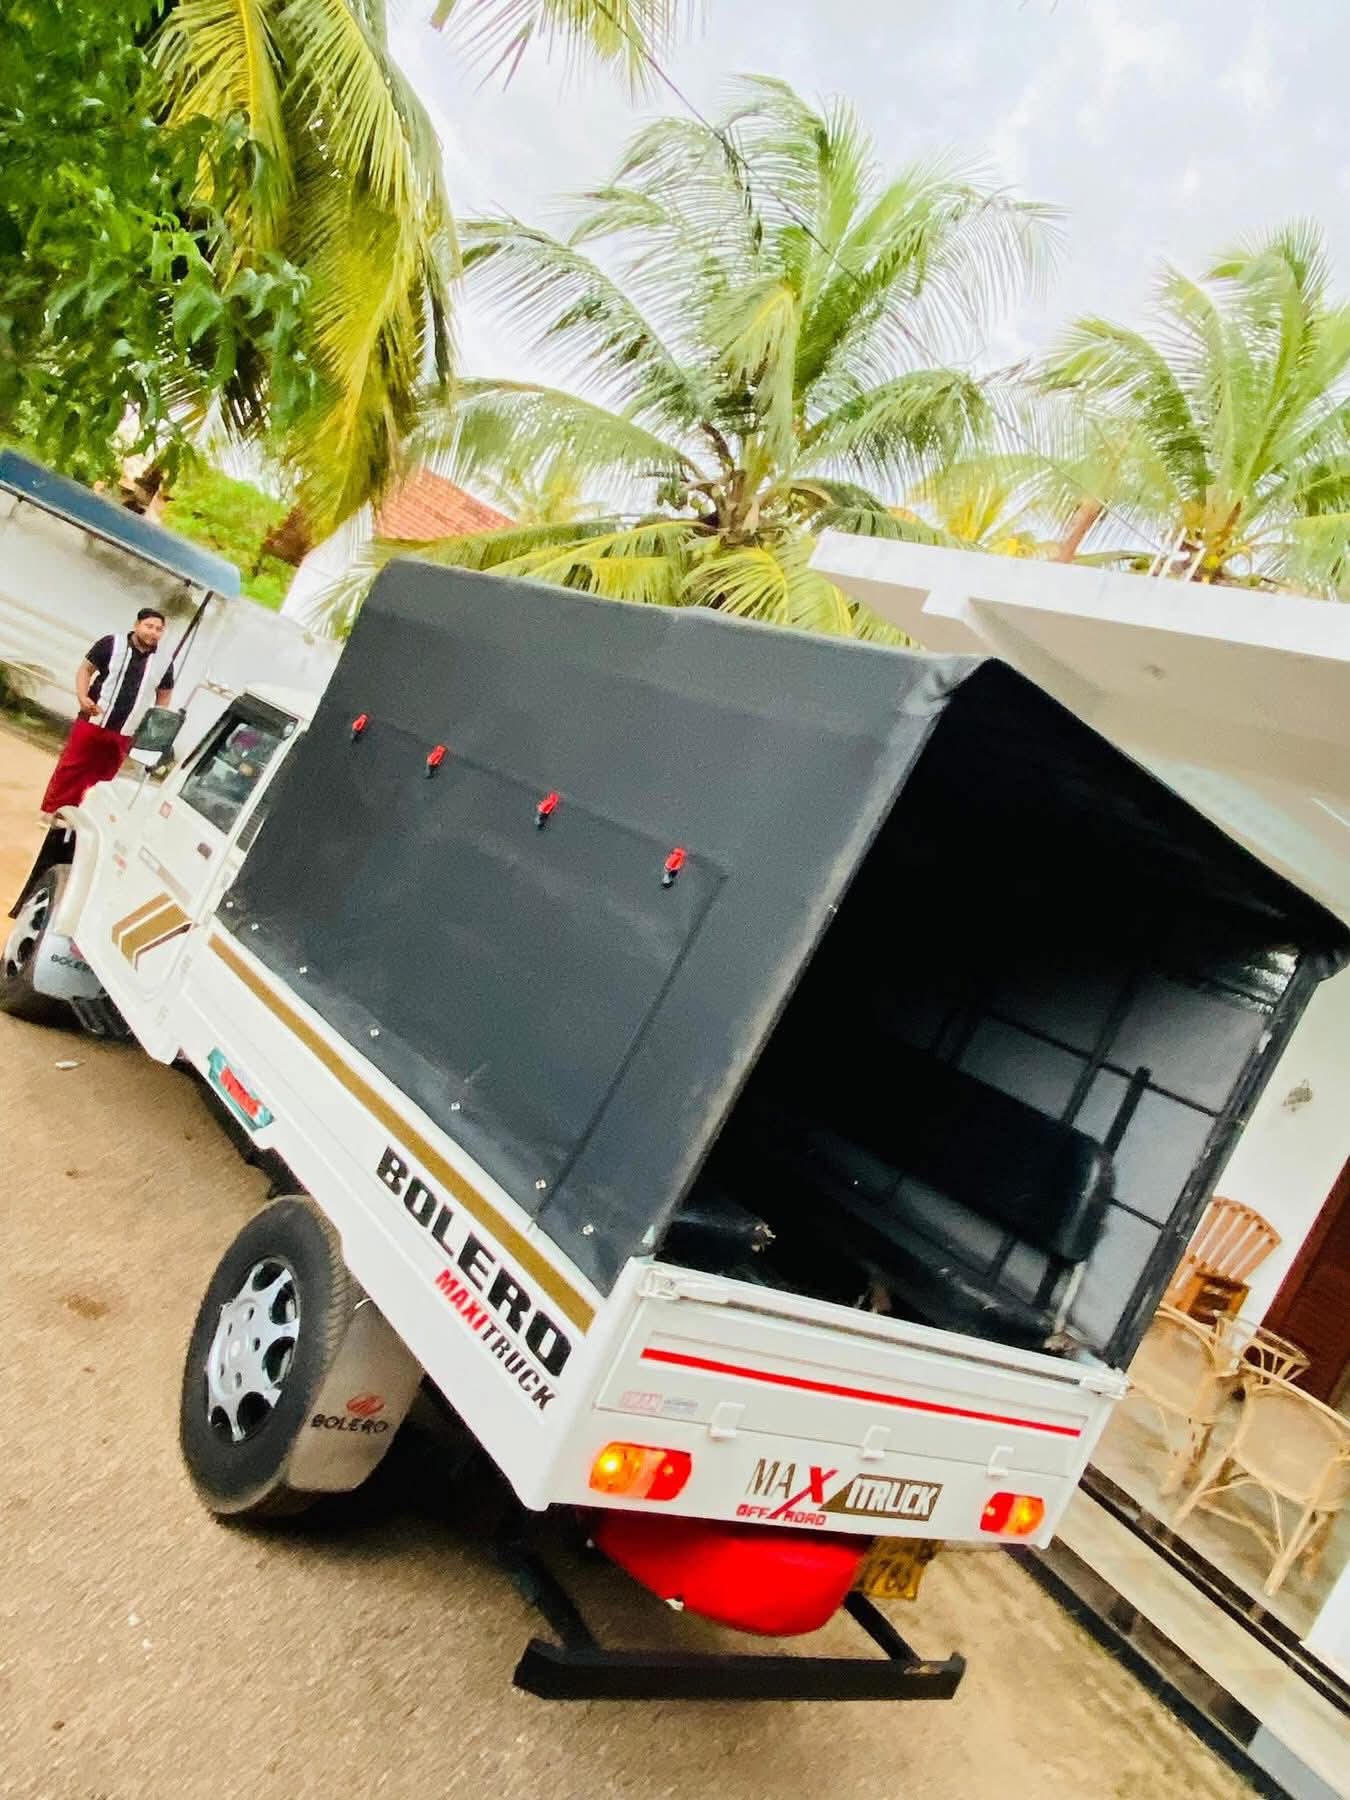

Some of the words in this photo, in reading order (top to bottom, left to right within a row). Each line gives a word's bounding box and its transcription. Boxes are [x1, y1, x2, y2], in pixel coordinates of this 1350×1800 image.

[376, 1145, 573, 1377] BOLERO
[311, 1413, 389, 1434] BOLERO
[735, 1503, 768, 1519] OFF
[783, 1510, 828, 1527] ROAD
